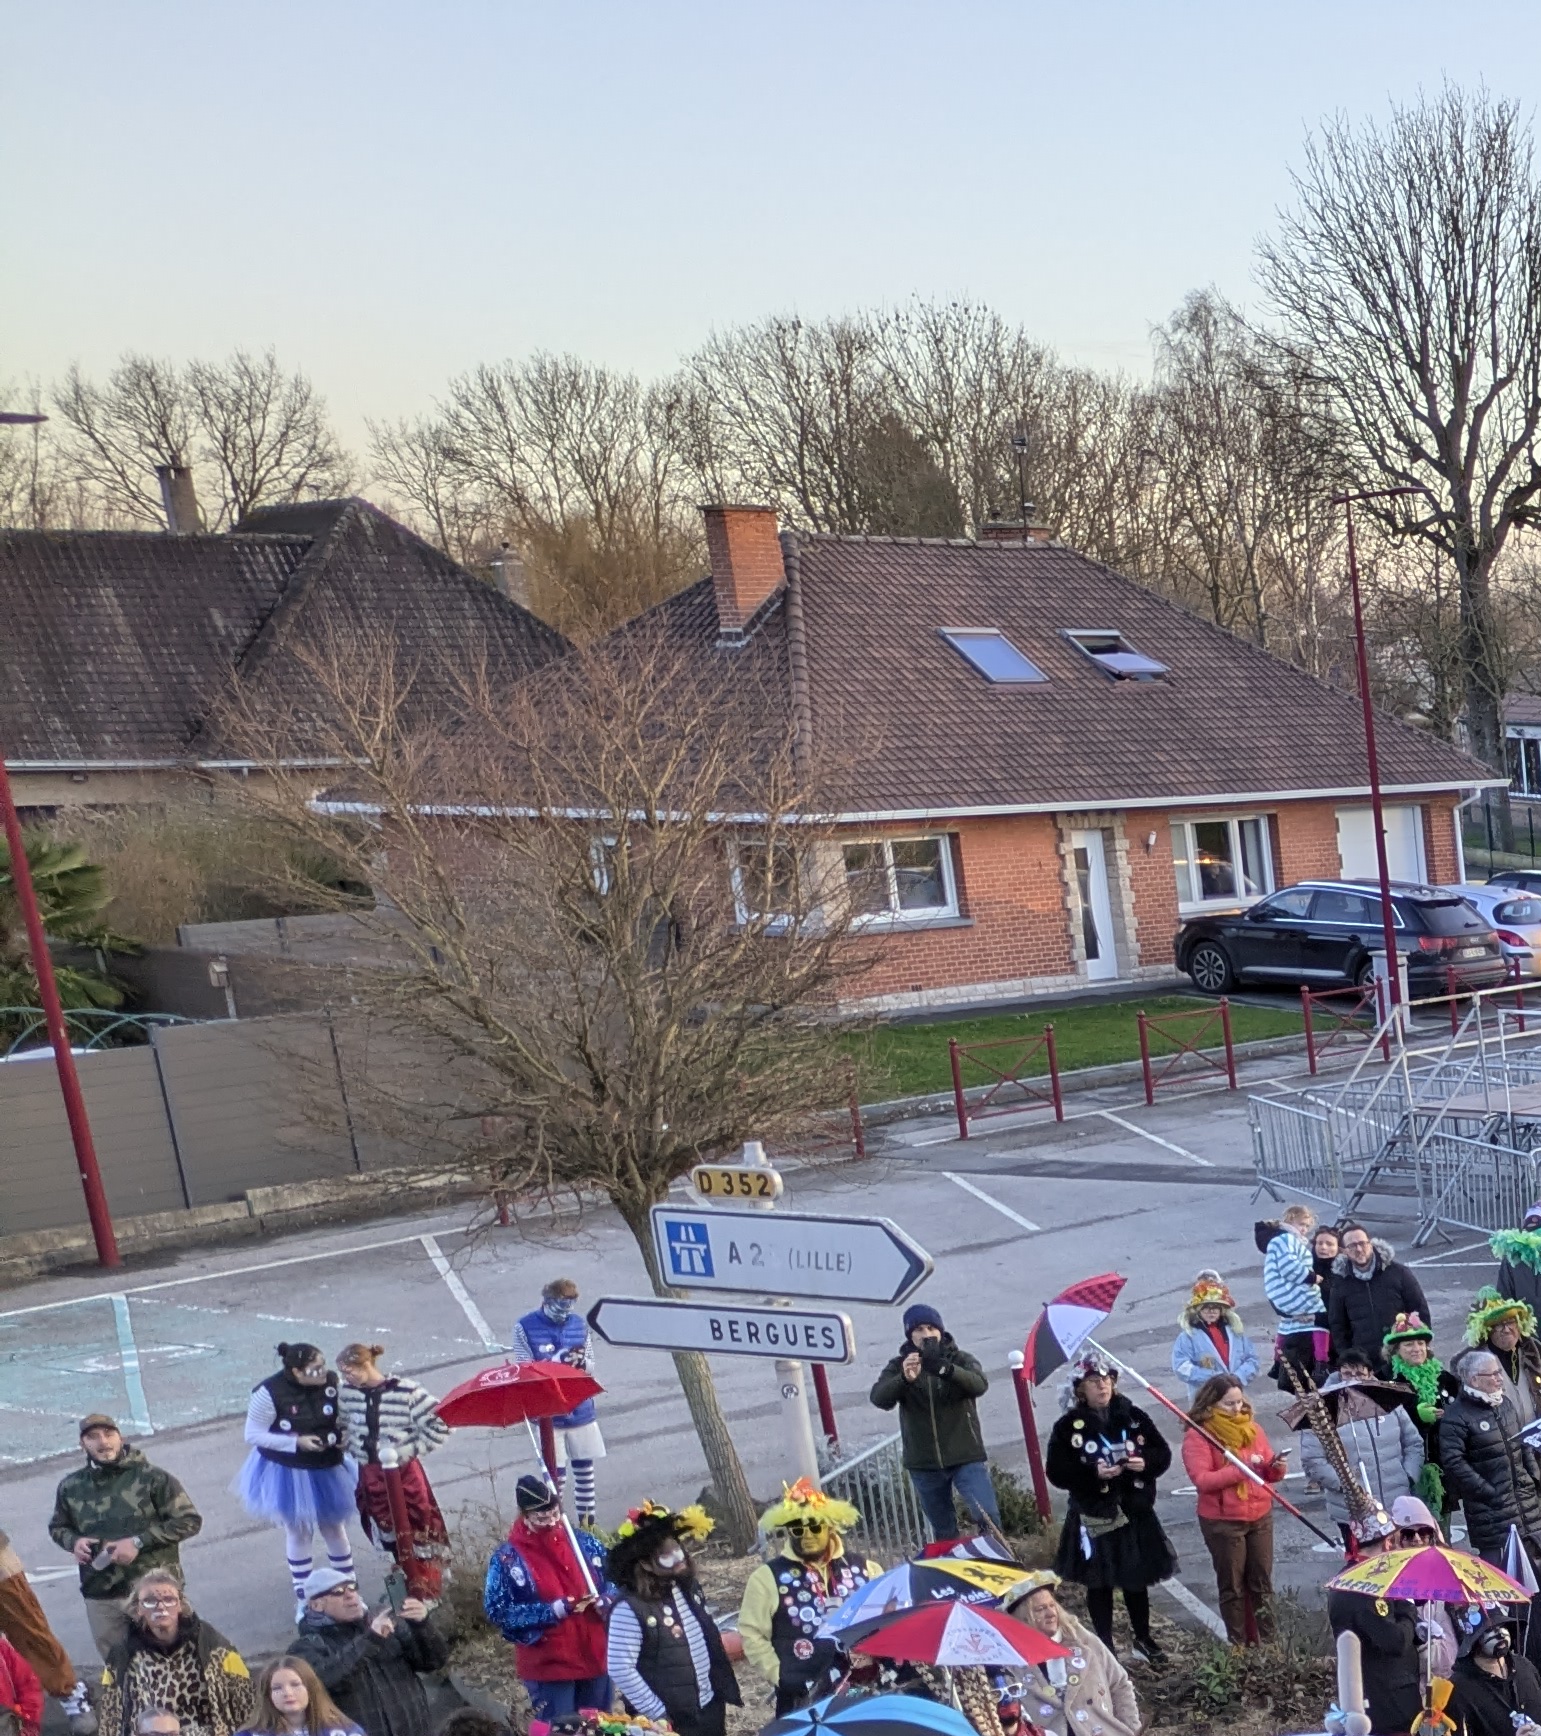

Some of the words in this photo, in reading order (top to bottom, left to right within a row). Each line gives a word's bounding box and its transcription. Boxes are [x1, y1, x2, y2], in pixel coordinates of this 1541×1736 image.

[698, 1171, 712, 1194] D
[722, 1173, 772, 1196] 352
[789, 1248, 853, 1274] (LILLE)
[710, 1319, 835, 1349] BERGUES
